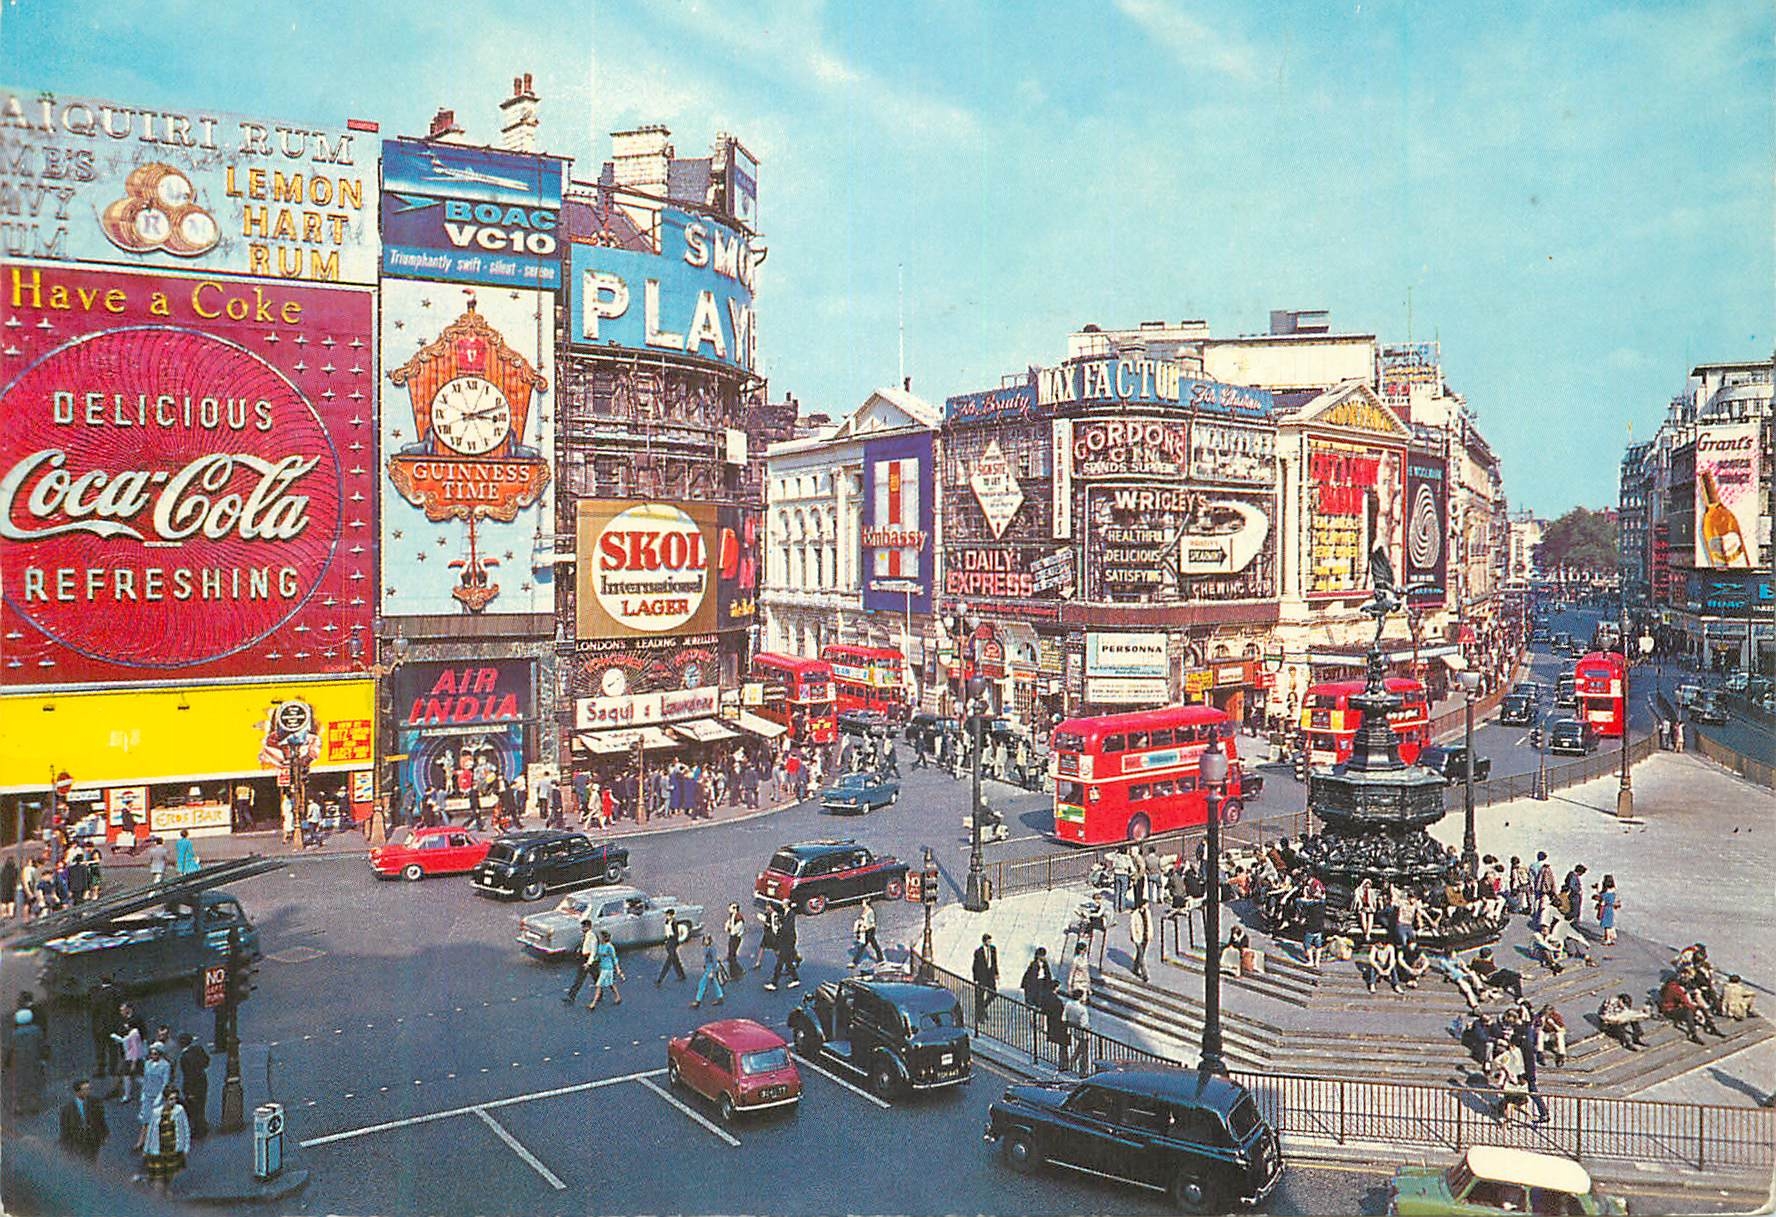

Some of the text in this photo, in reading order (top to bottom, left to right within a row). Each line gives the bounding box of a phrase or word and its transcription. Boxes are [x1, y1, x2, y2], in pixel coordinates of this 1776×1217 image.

[239, 121, 354, 166] RUM
[226, 164, 363, 209] LEMON
[242, 203, 348, 244] HART
[444, 199, 558, 230] BOAC
[443, 222, 557, 255] VC10
[248, 242, 340, 281] RUM
[389, 248, 453, 273] Triumphantly
[457, 256, 481, 273] swift
[489, 260, 516, 277] silent
[11, 267, 304, 325] Have a Coke
[1037, 362, 1077, 406] MAX
[53, 390, 272, 431] DELICIOUS
[1075, 421, 1185, 464] GORDON'S
[1111, 447, 1156, 463] GIN
[1697, 432, 1754, 452] Grant's
[412, 462, 531, 483] GUINNESS
[0, 449, 321, 540] Coca-Cola
[443, 481, 500, 500] TIME
[1115, 490, 1208, 513] WRIGLEY'S
[861, 525, 928, 552] Embassy
[1107, 530, 1165, 542] HEALTHFUL
[600, 530, 708, 572] SKOL
[965, 550, 1014, 571] DAILY
[1106, 549, 1163, 563] DELICIOUS
[25, 567, 298, 603] REFRESHING
[600, 574, 704, 596] International
[946, 571, 1033, 597] EXPRESS
[1105, 569, 1162, 583] SATISFYING
[621, 598, 690, 617] LAGER
[636, 637, 677, 649] LEADING
[1101, 645, 1162, 653] PERSONNA
[431, 667, 498, 695] AIR
[408, 692, 518, 725] INDIA
[587, 700, 634, 724] Saqui
[206, 969, 225, 985] NO
